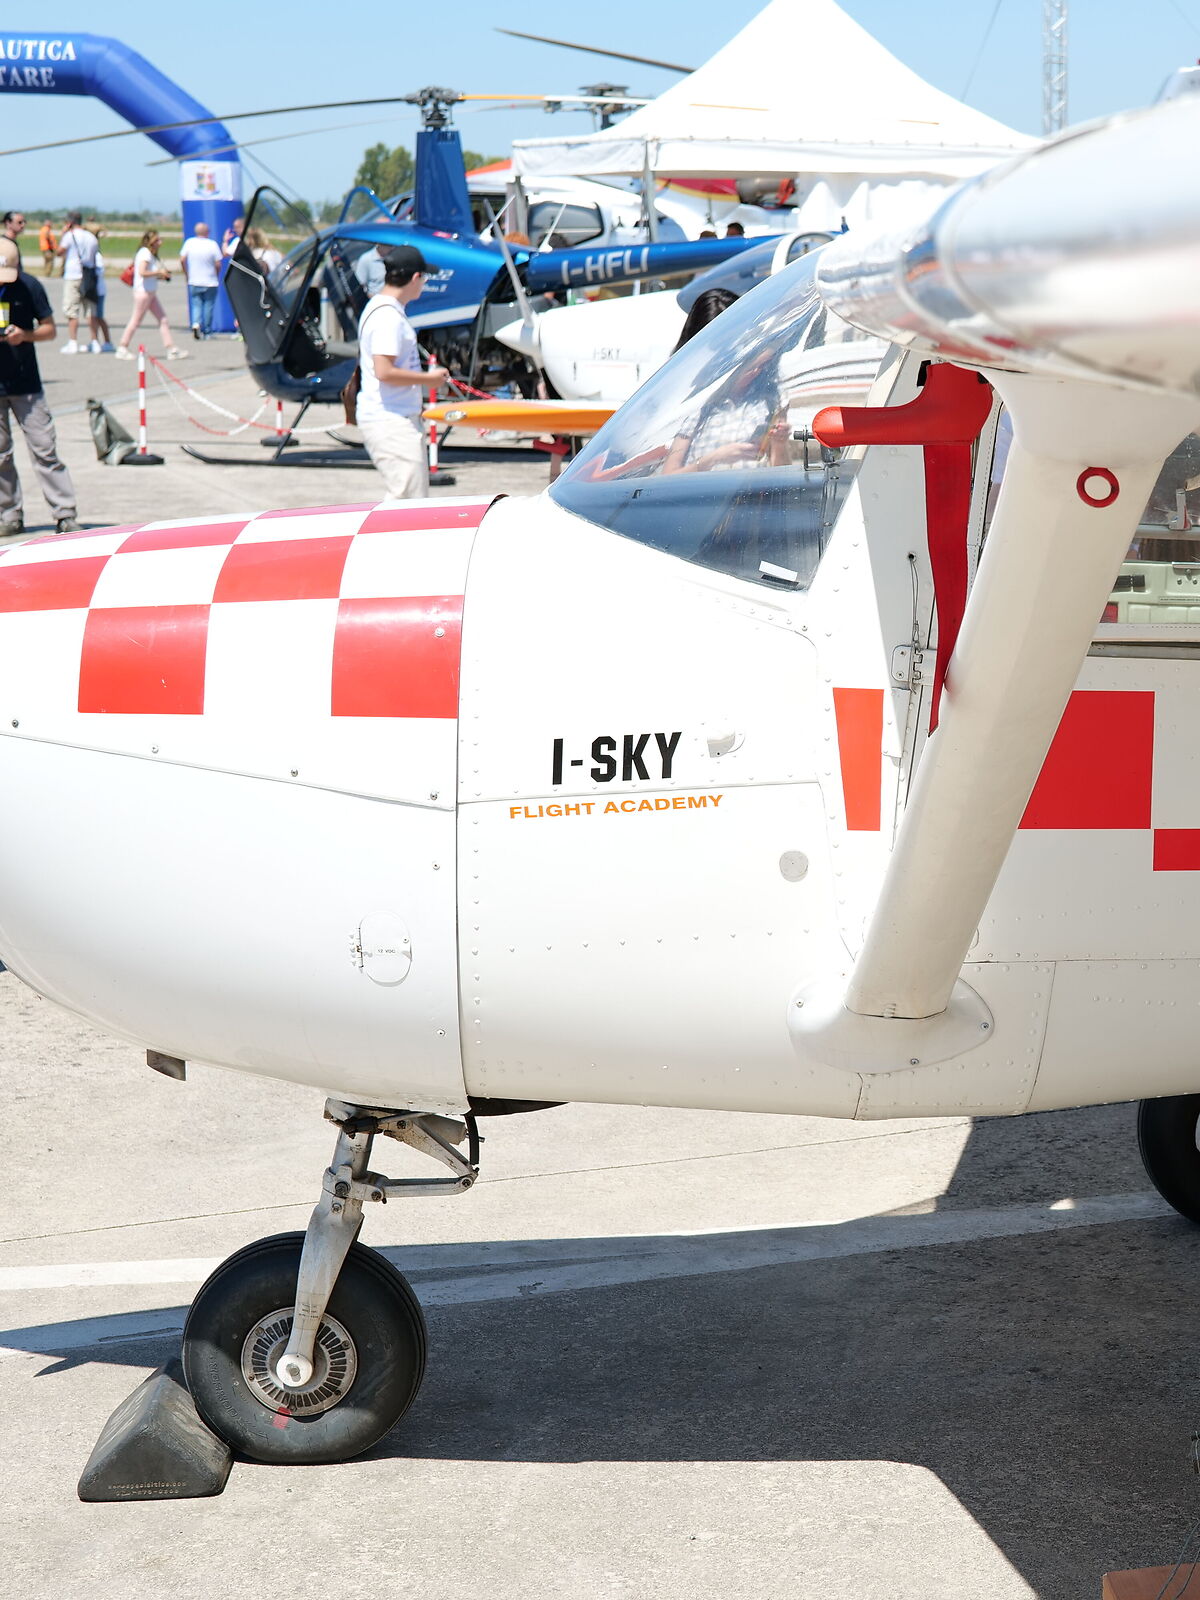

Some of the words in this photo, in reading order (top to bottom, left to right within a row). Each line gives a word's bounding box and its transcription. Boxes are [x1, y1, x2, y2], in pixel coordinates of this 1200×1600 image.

[561, 247, 650, 285] I-HFLI
[552, 732, 682, 785] I-SKY
[509, 803, 596, 819] FLIGHT
[603, 794, 723, 814] ACADEMY
